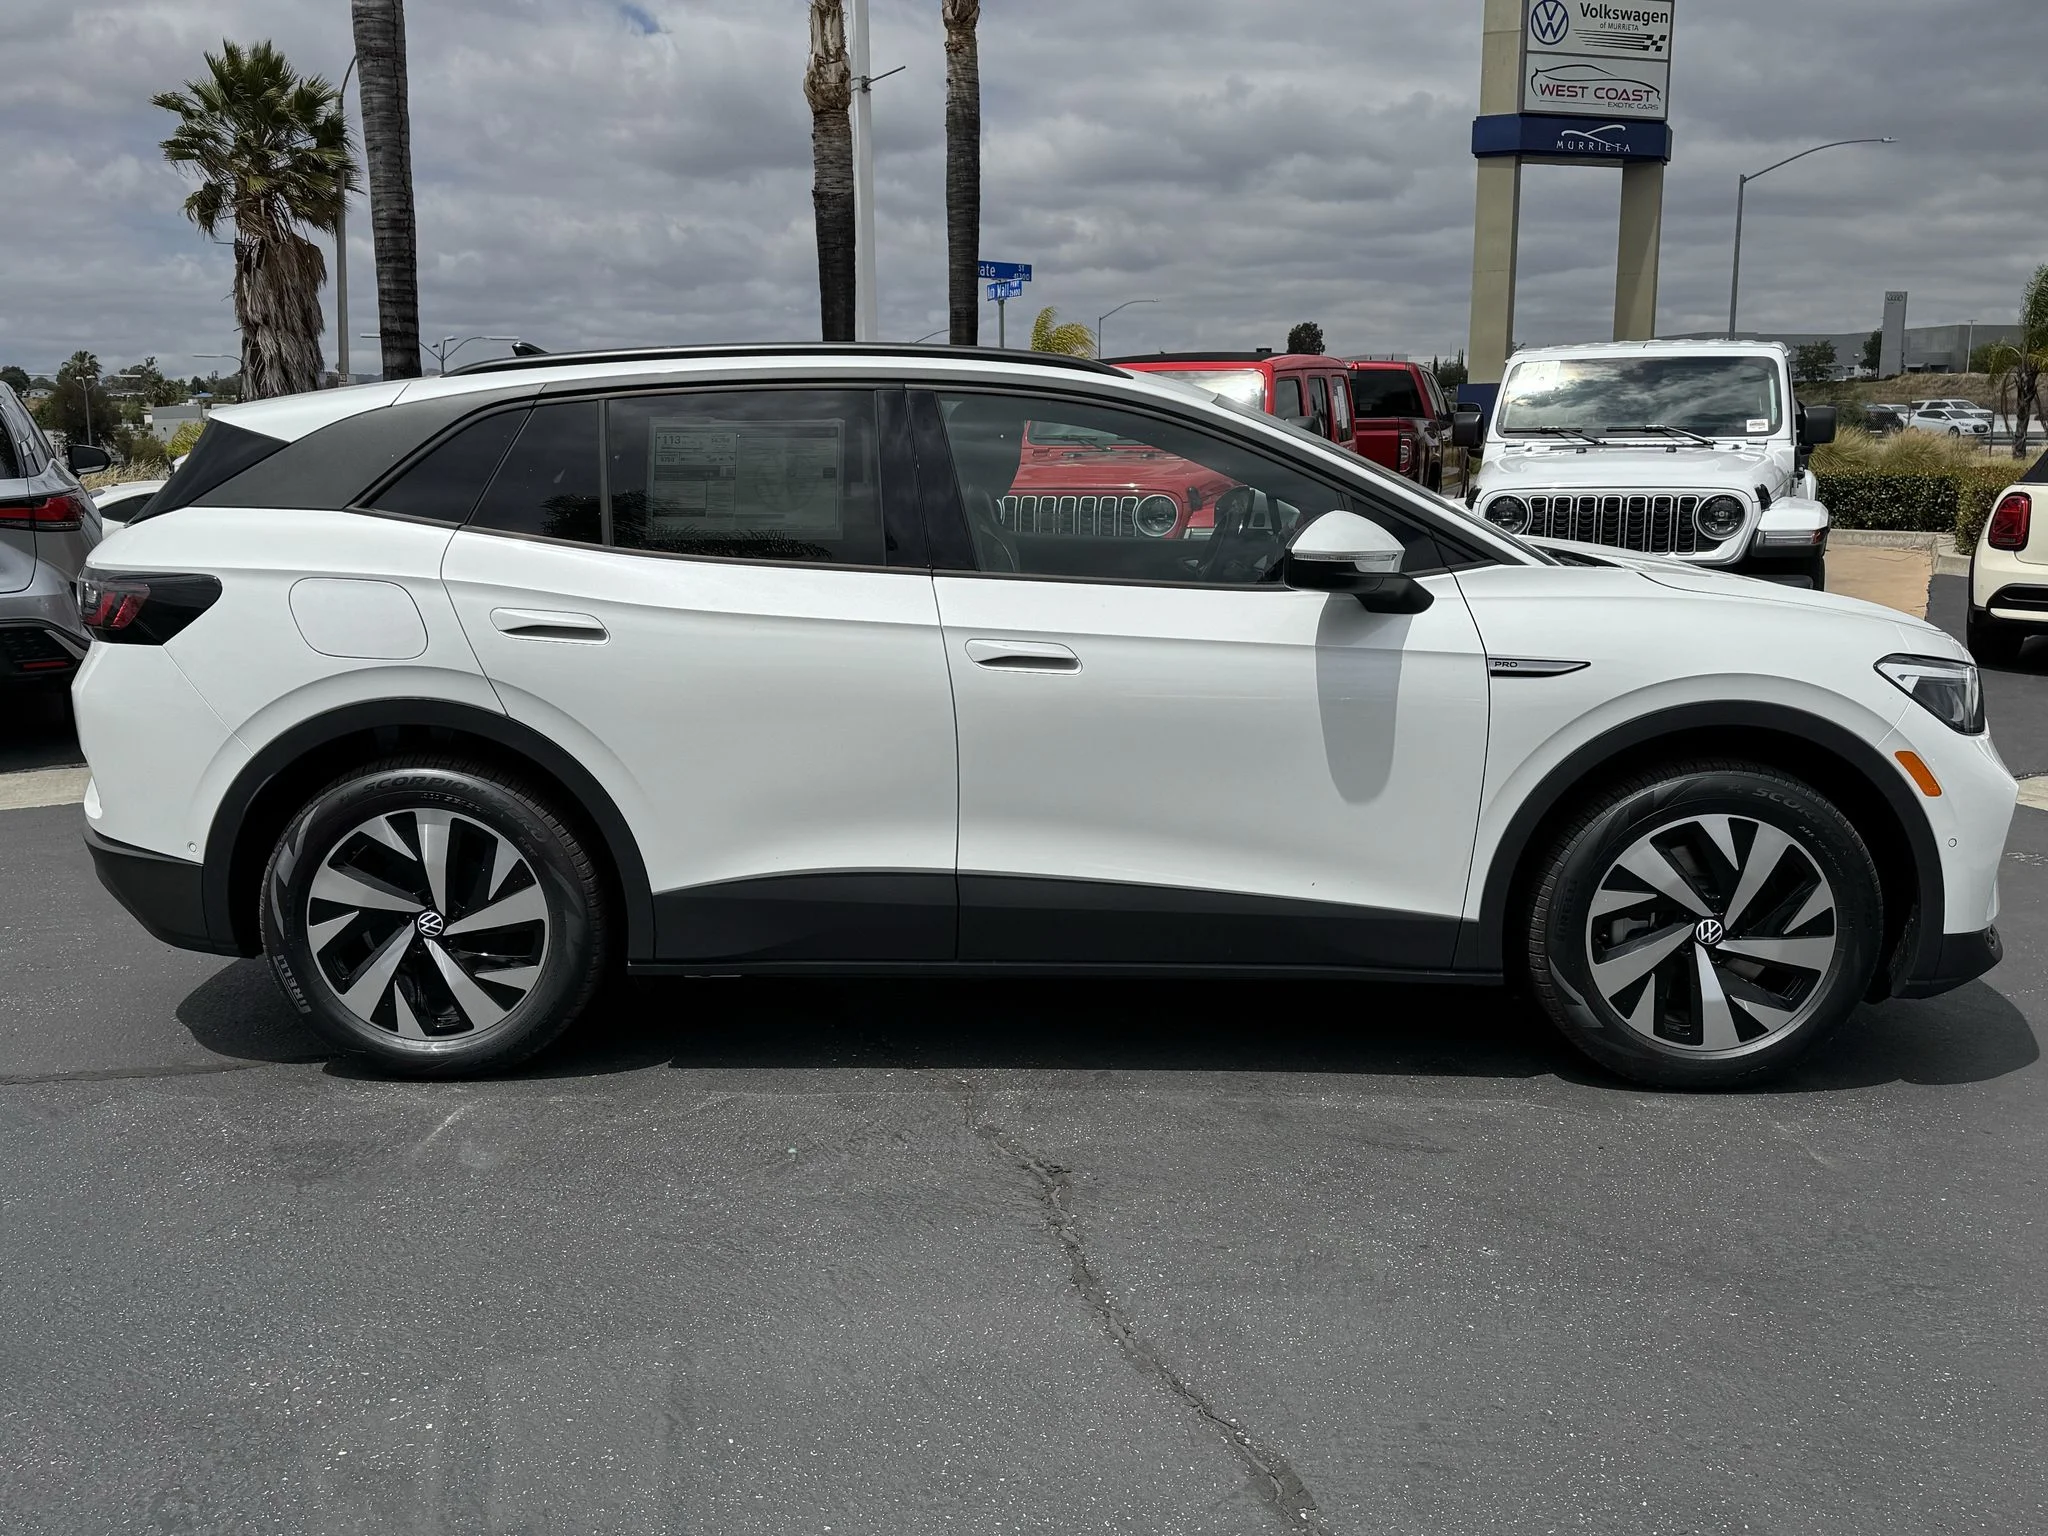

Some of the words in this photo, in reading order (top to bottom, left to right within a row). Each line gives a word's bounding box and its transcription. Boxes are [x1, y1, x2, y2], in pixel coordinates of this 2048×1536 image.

[1580, 2, 1669, 26] Volkswagen
[1600, 22, 1607, 30] of
[1607, 23, 1639, 31] MURRIETA
[1539, 83, 1589, 99] WEST
[1593, 87, 1654, 102] COAST
[1607, 101, 1635, 109] EXOTIC
[1556, 140, 1631, 152] MURRIETA
[978, 263, 996, 277] ate
[363, 776, 487, 797] SCORPION
